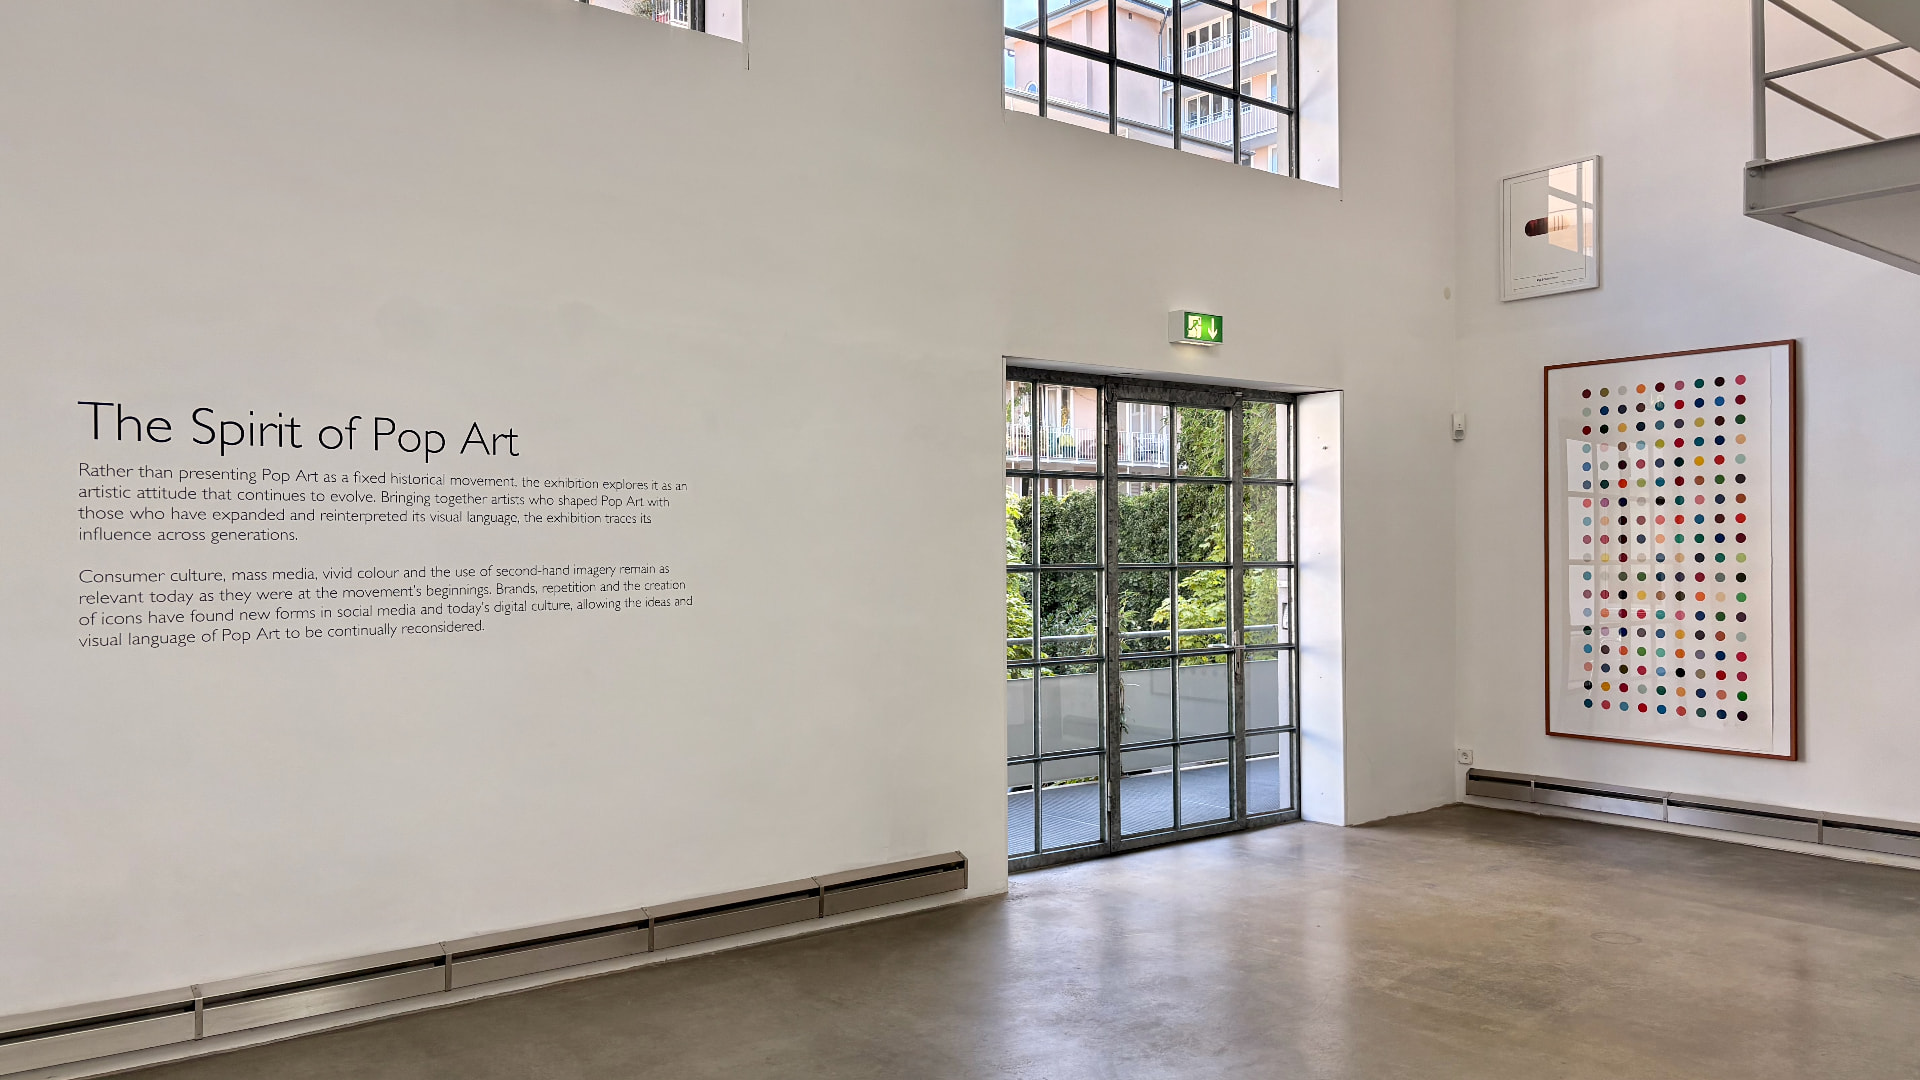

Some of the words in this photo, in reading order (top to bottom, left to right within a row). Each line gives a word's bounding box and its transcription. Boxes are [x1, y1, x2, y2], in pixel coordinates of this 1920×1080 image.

[77, 401, 171, 443] The
[192, 408, 302, 456] Spirit
[319, 416, 362, 450] of
[375, 417, 445, 463] Pop
[460, 422, 519, 456] Art
[80, 463, 134, 477] Rather
[138, 465, 172, 478] than
[180, 468, 257, 484] presenting
[263, 468, 290, 485] Pop
[296, 470, 318, 482] Art
[324, 474, 336, 482] as
[342, 475, 349, 483] a
[353, 471, 385, 483] fixed
[391, 472, 445, 485] historical
[522, 477, 539, 487] the
[544, 477, 598, 488] exhibition
[603, 479, 648, 491] explores
[652, 481, 658, 490] it
[79, 485, 131, 498] artistic
[137, 486, 196, 499] attitude
[202, 487, 232, 500] that
[238, 489, 305, 501] continues
[310, 491, 325, 501] to
[331, 490, 375, 502] evolve.
[382, 491, 430, 507] Bringing
[434, 493, 488, 507] together
[491, 493, 524, 505] artists
[529, 494, 554, 505] who
[559, 495, 597, 509] shaped
[602, 495, 622, 509] Pop
[626, 496, 644, 506] Art
[647, 497, 669, 507] with
[77, 506, 124, 519] those
[130, 507, 164, 519] who
[172, 507, 206, 520] have
[213, 508, 284, 524] expanded
[290, 509, 314, 521] and
[321, 509, 407, 525] reinterpreted
[413, 510, 425, 522] its
[430, 511, 462, 522] visual
[467, 511, 519, 526] language,
[524, 512, 542, 522] the
[547, 512, 601, 523] exhibition
[604, 514, 636, 523] traces
[641, 513, 651, 523] its
[80, 527, 151, 540] influence
[158, 532, 205, 540] across
[211, 528, 297, 544] generations.
[79, 570, 165, 583] Consumer
[171, 569, 225, 582] culture,
[232, 572, 267, 580] mass
[273, 568, 317, 580] media,
[323, 567, 352, 579] vivid
[358, 567, 399, 578] colour
[404, 566, 425, 578] and
[430, 566, 450, 577] the
[456, 569, 475, 577] use
[480, 565, 493, 576] of
[496, 565, 569, 576] second-hand
[574, 564, 616, 578] imagery
[620, 563, 655, 574] remain
[80, 591, 144, 604] relevant
[149, 590, 193, 606] today
[199, 593, 214, 601] as
[219, 588, 251, 604] they
[256, 591, 292, 600] were
[298, 589, 311, 599] at
[315, 587, 337, 598] the
[343, 585, 421, 598] movement's
[427, 584, 491, 599] beginnings.
[497, 583, 537, 594] Brands,
[543, 581, 595, 596] repetition
[600, 580, 619, 591] and
[623, 580, 640, 591] the
[645, 581, 685, 590] creation
[79, 612, 97, 625] of
[102, 612, 142, 625] icons
[149, 611, 184, 623] have
[190, 609, 233, 622] found
[240, 611, 270, 620] new
[275, 607, 315, 619] forms
[321, 606, 331, 618] in
[338, 605, 372, 617] social
[378, 604, 415, 616] media
[421, 603, 442, 615] and
[447, 602, 489, 616] today's
[494, 600, 526, 615] digital
[532, 600, 572, 611] culture,
[577, 599, 621, 611] allowing
[624, 597, 641, 607] the
[646, 596, 670, 607] ideas
[675, 595, 692, 606] and
[79, 633, 121, 647] visual
[129, 633, 195, 648] language
[202, 629, 218, 642] of
[223, 629, 250, 644] Pop
[256, 628, 280, 640] Art
[285, 628, 300, 638] to
[306, 626, 322, 638] be
[328, 623, 397, 638] continually
[402, 620, 484, 634] reconsidered.
